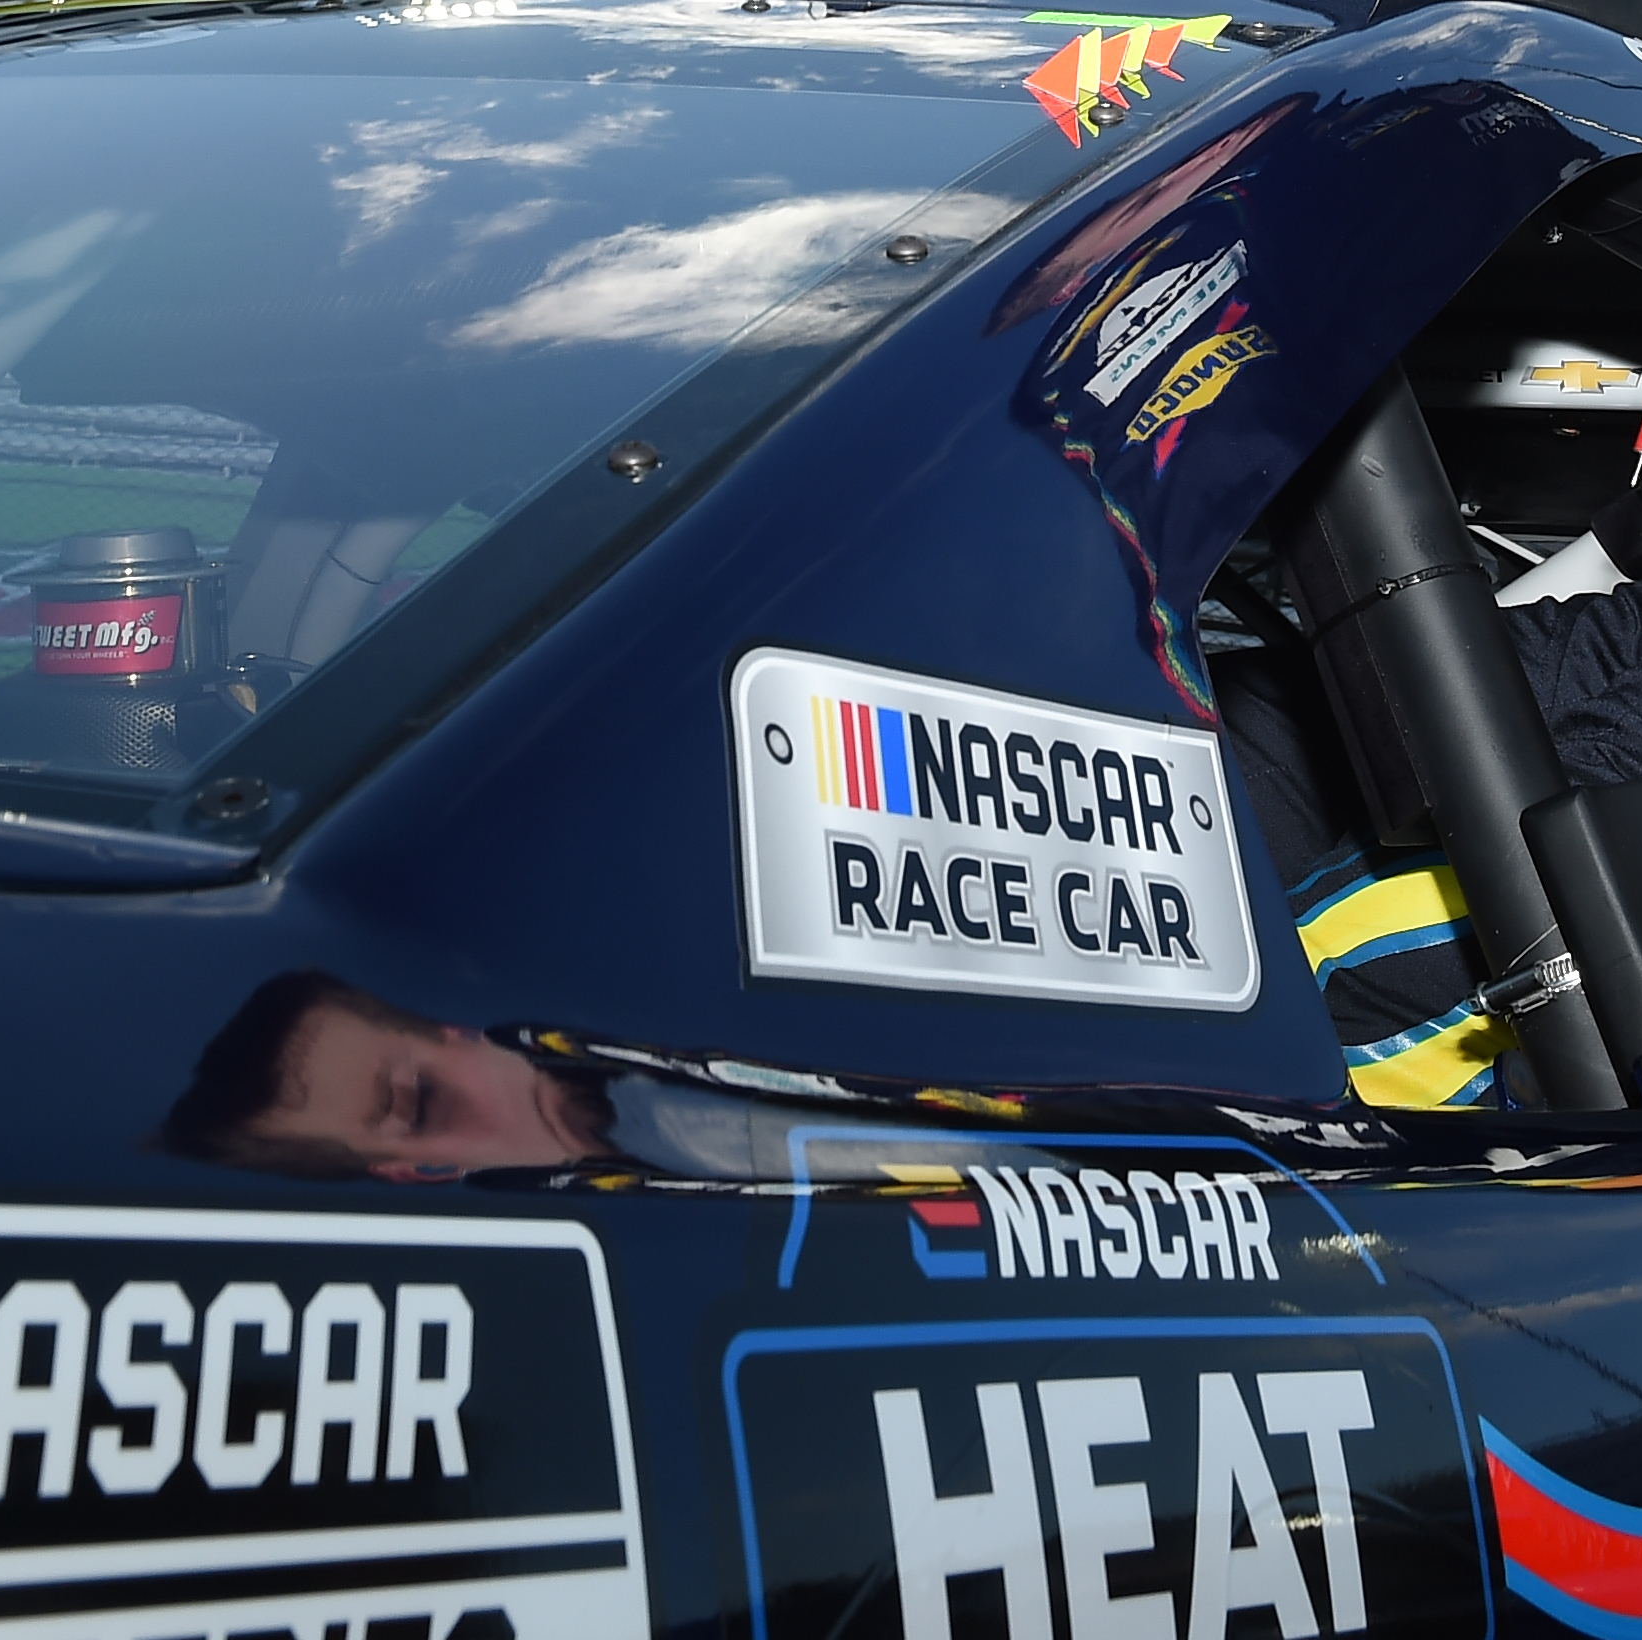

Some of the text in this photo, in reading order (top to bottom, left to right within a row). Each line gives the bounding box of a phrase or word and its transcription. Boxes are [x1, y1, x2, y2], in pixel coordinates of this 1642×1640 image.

[909, 712, 1183, 855] NASCAR
[832, 840, 1201, 960] RACE CAR
[967, 1165, 1281, 1281] NASCAR
[873, 1370, 1376, 1640] HEAT
